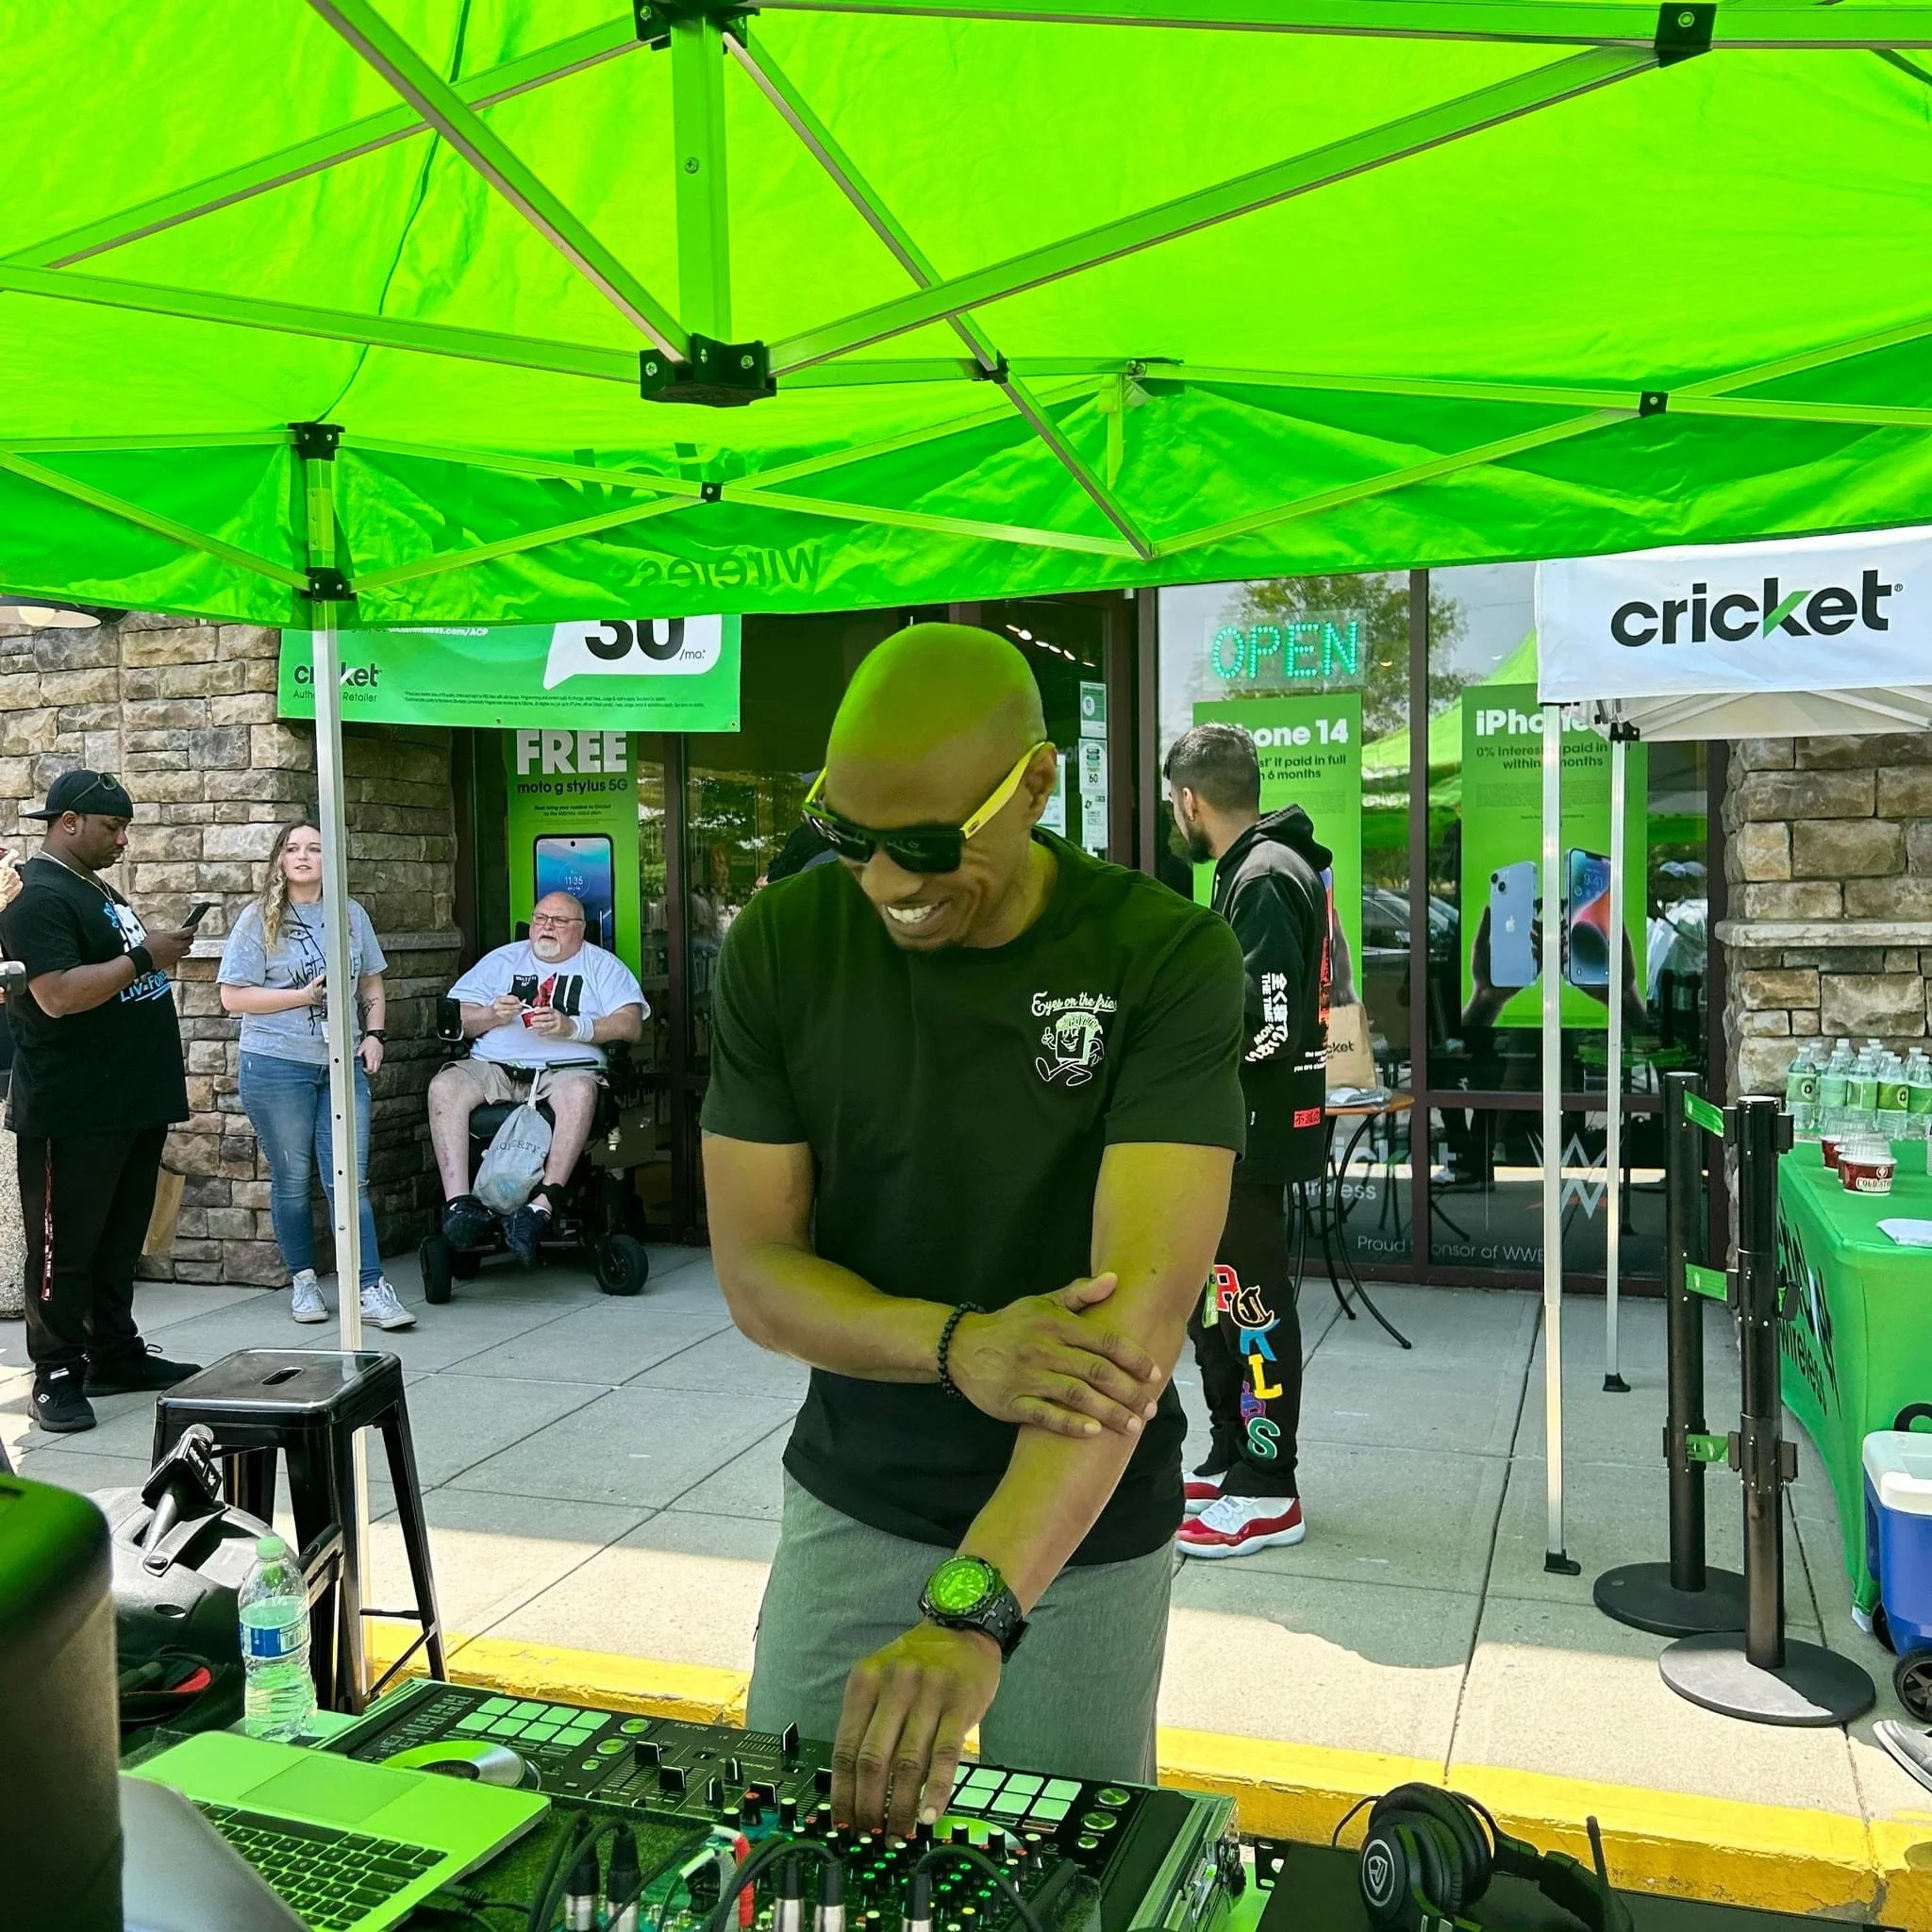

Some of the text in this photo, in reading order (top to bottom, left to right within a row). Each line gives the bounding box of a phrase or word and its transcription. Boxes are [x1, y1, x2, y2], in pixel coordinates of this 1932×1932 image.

[1610, 569, 1893, 648] cricket
[1212, 619, 1358, 679] OPEN
[343, 691, 377, 703] Retailer
[1316, 718, 1349, 744] 14
[516, 729, 627, 775] FREE
[1563, 742, 1593, 758] paid
[1285, 756, 1312, 769] paid
[1328, 754, 1346, 765] full
[1503, 758, 1541, 770] within
[1277, 768, 1322, 780] months
[518, 777, 628, 795] moto g stylus 5G
[1031, 991, 1063, 1017] Eyes
[1063, 997, 1078, 1007] on
[1078, 991, 1095, 1008] the
[1357, 1235, 1406, 1253] Proud
[1481, 1244, 1498, 1259] of
